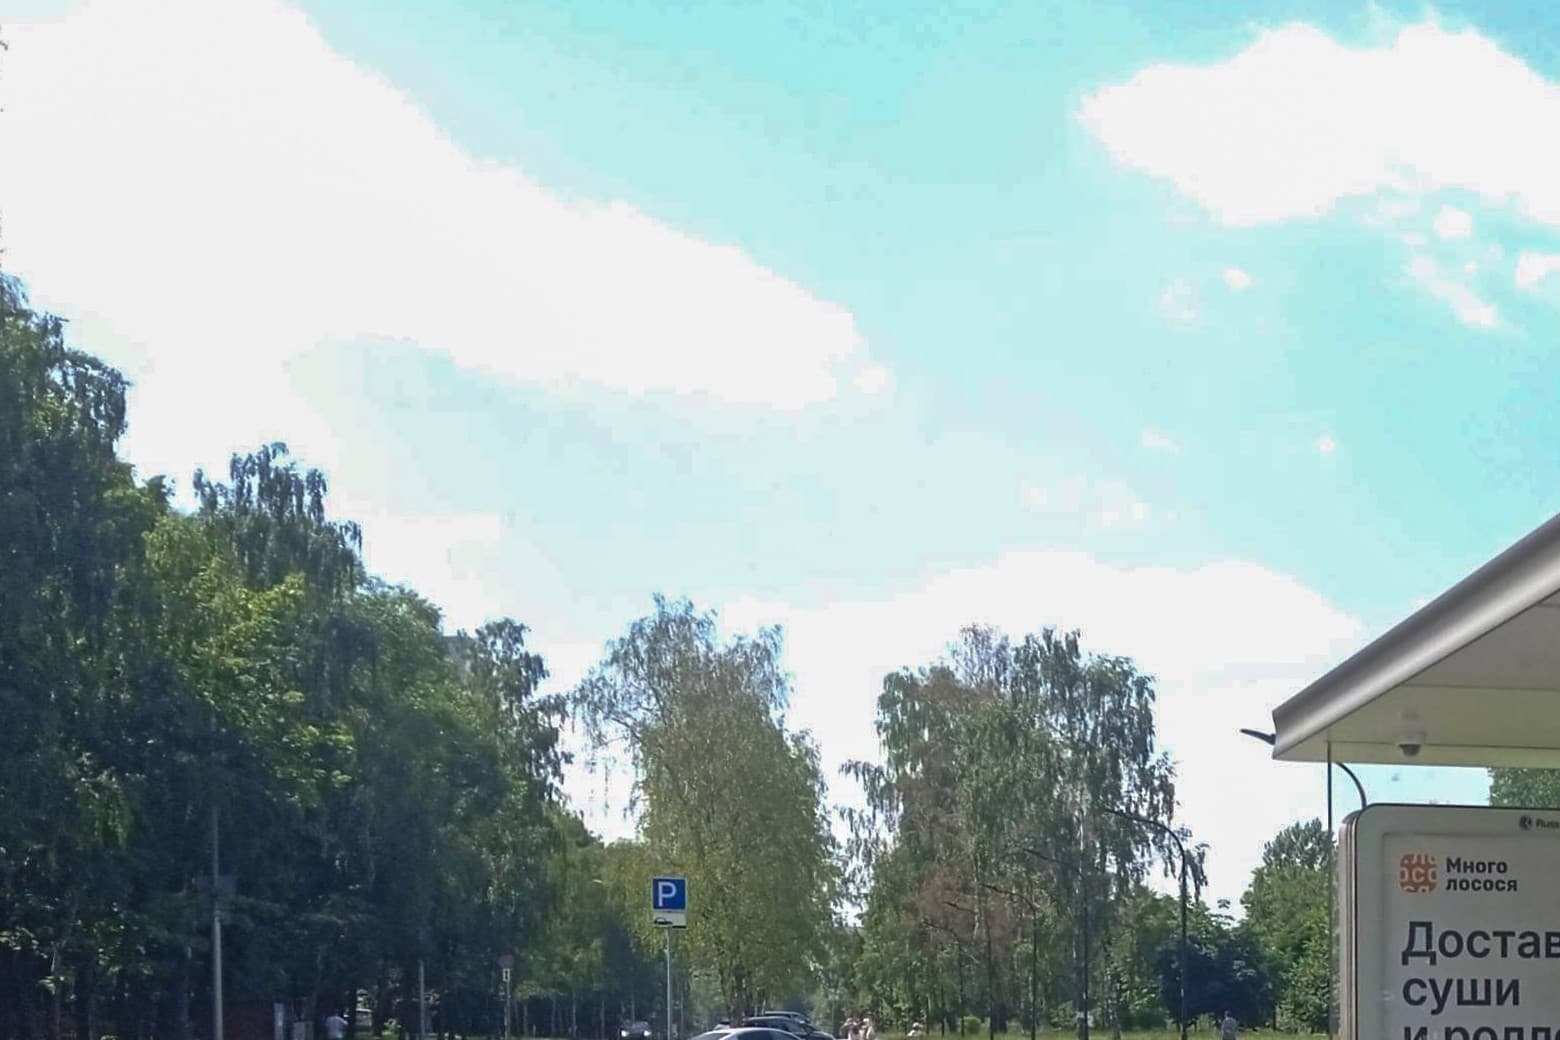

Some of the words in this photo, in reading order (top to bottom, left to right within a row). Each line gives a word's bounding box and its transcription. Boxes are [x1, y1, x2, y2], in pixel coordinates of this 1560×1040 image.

[1446, 857, 1508, 875] Много
[658, 881, 677, 907] P
[1445, 878, 1518, 893] лосося
[1402, 977, 1520, 1015] суши
